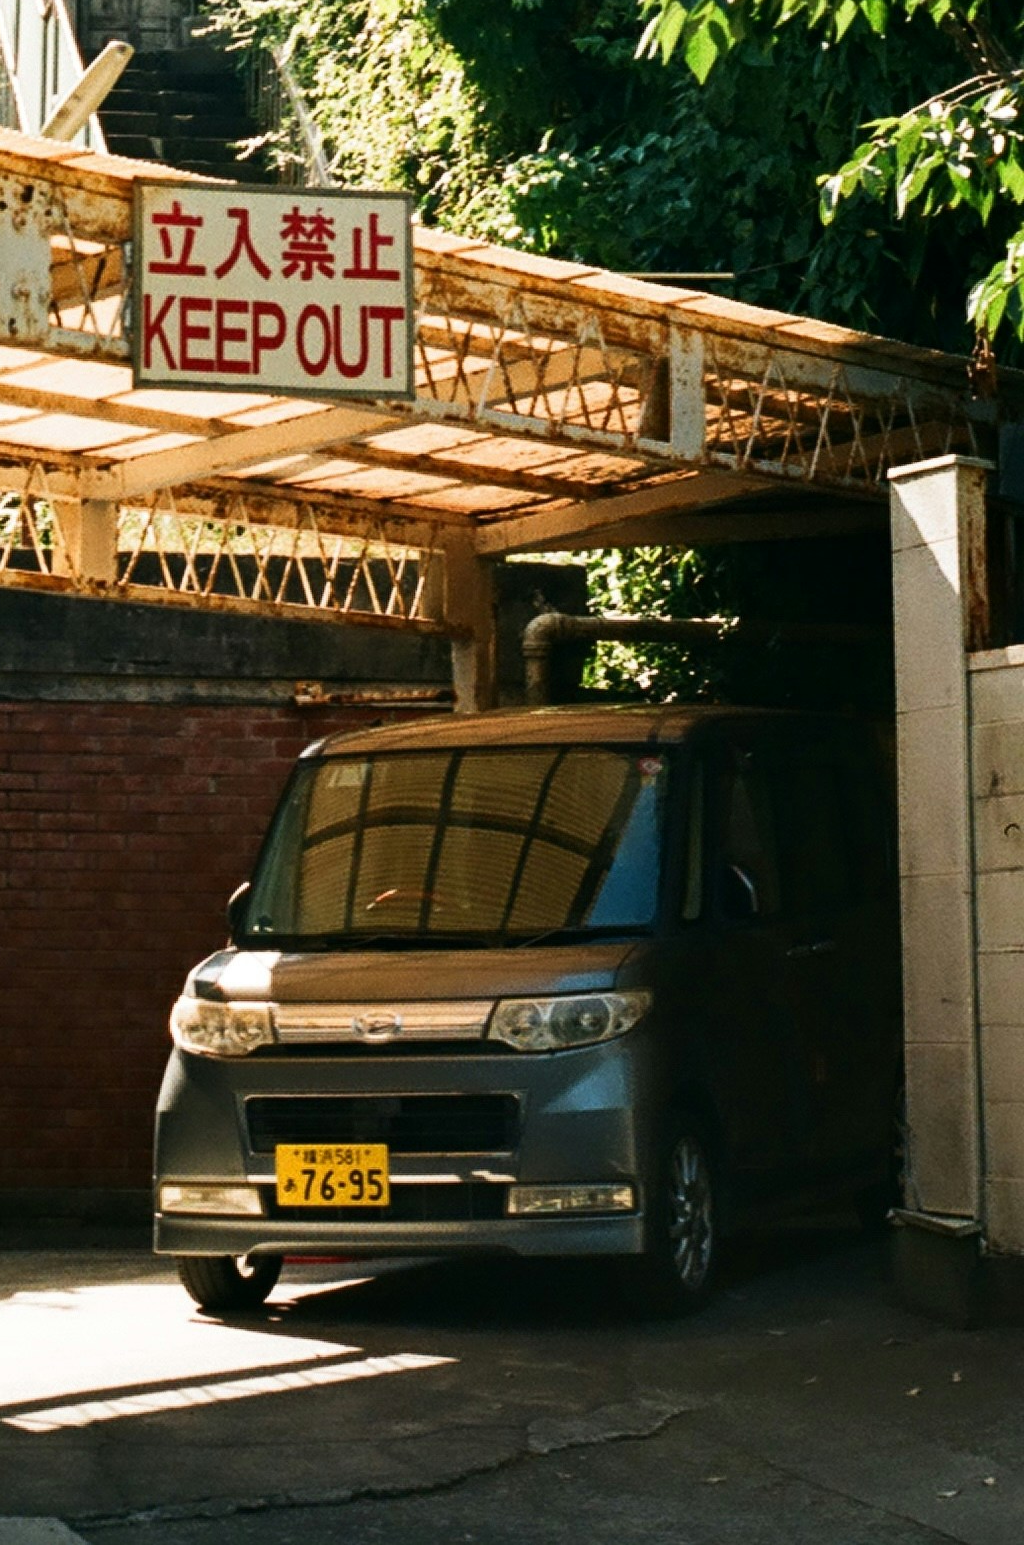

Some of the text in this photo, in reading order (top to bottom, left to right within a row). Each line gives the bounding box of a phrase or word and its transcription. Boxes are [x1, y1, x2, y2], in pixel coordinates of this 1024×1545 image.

[148, 200, 400, 281] 立入禁止
[143, 293, 405, 378] KEEP OUT
[301, 1168, 383, 1201] 76-95
